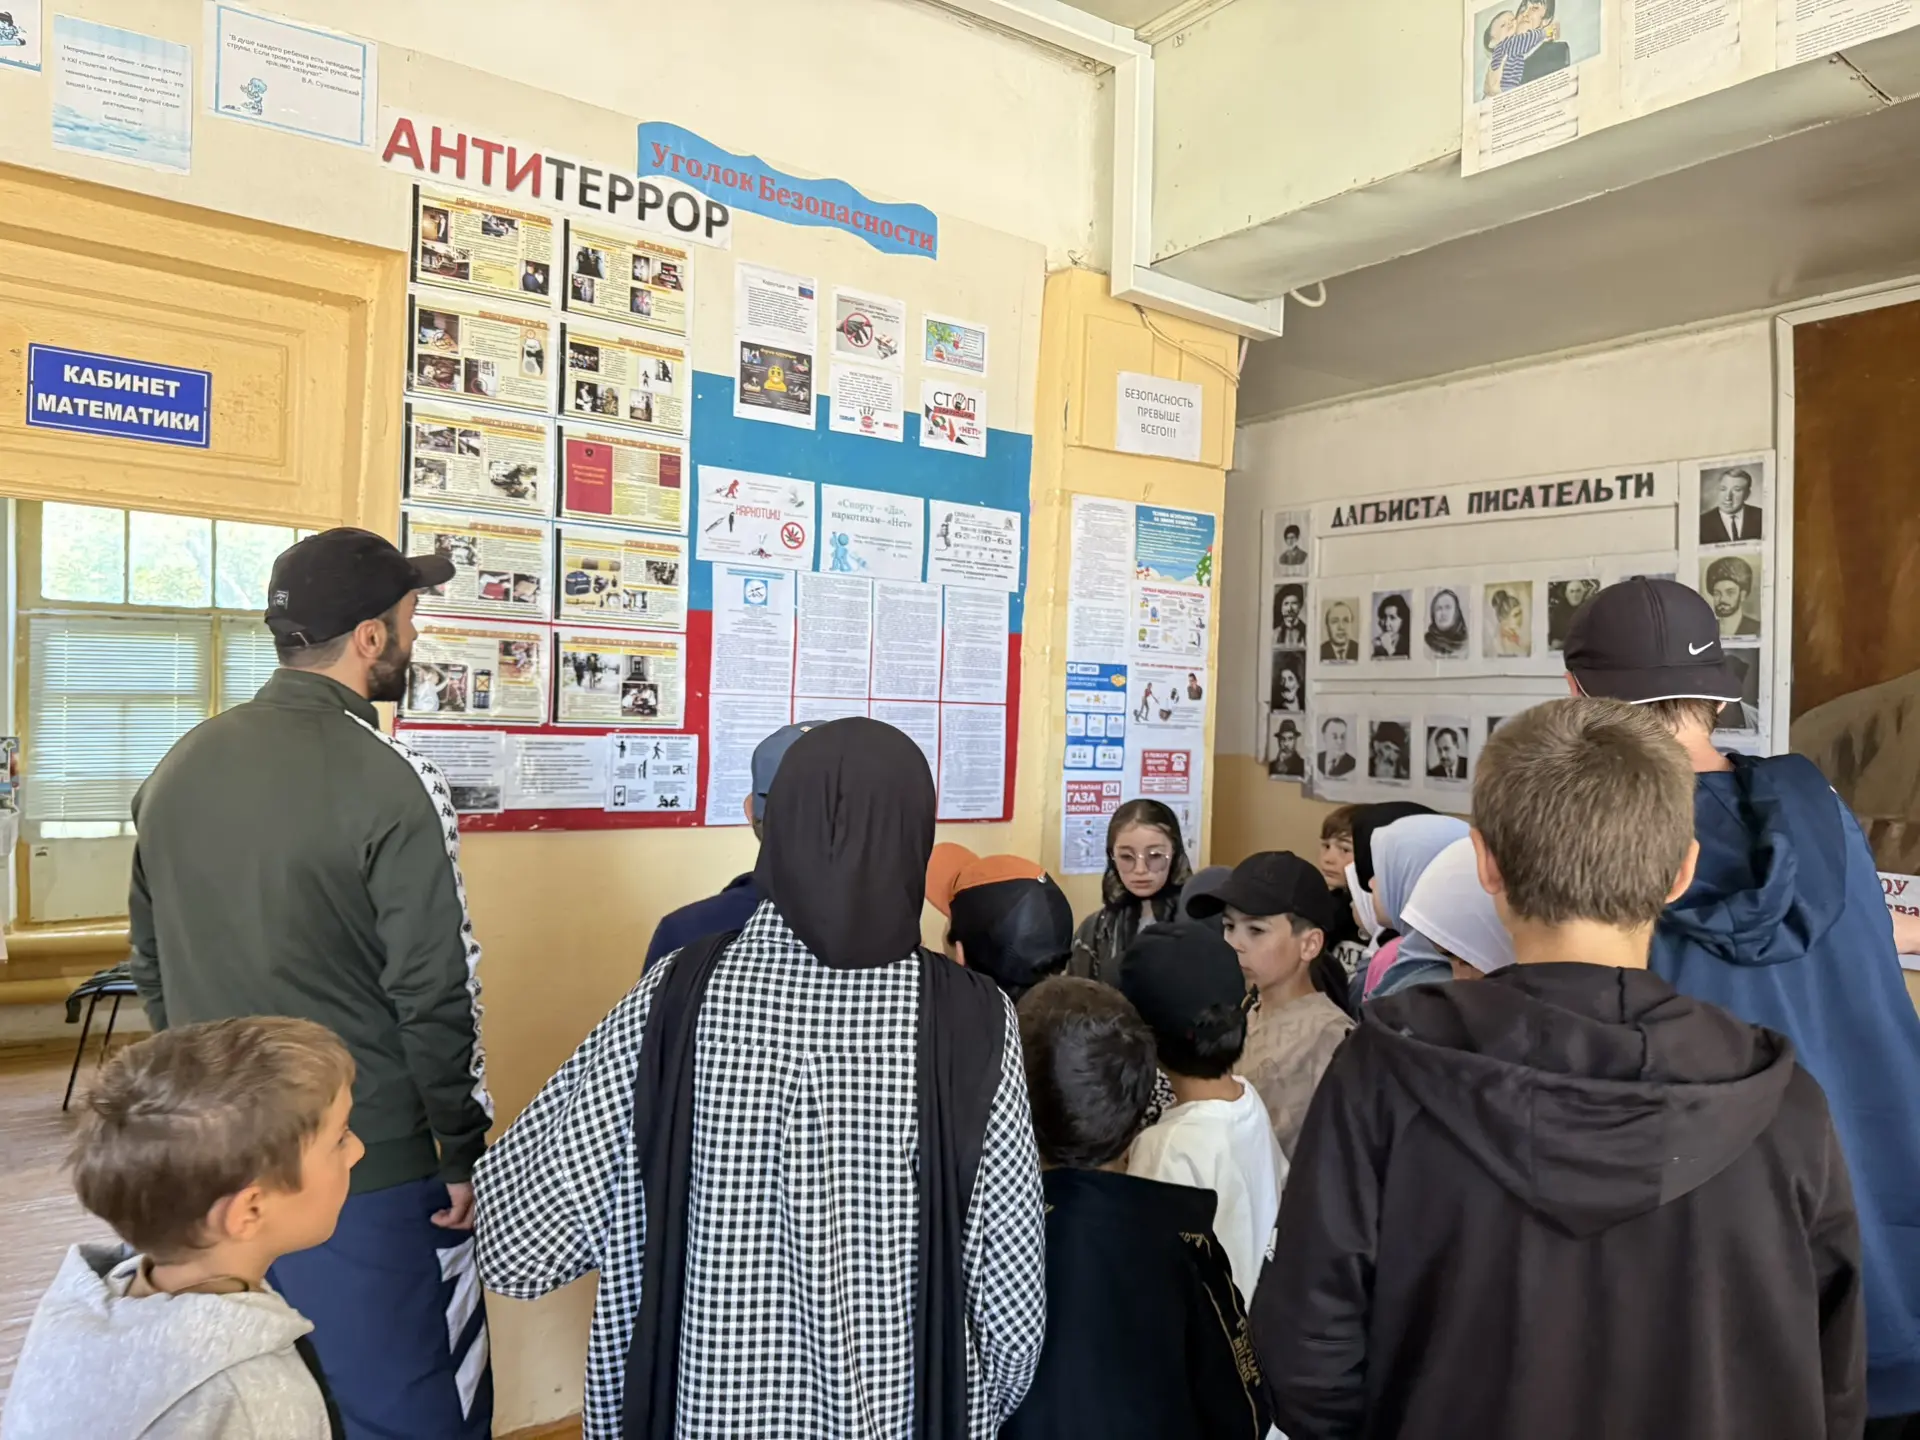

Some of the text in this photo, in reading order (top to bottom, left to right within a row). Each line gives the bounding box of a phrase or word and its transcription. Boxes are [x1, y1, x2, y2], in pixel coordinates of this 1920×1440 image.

[382, 116, 731, 239] АНТИТЕРРОР
[650, 140, 935, 252] Уголок Безопасности
[62, 363, 181, 399] КАБИНЕТ
[1124, 387, 1194, 409] БЕЗОПАСНОСТЬ
[36, 392, 200, 433] МАТЕМАТИКИ
[1137, 406, 1181, 423] ПРЕВЫШЕ
[1140, 423, 1177, 439] ВСЕГО!!!
[1330, 471, 1655, 529] ДАГЪИСТА ПИСАТЕЛЬТИ
[1066, 791, 1097, 804] ГАЗА
